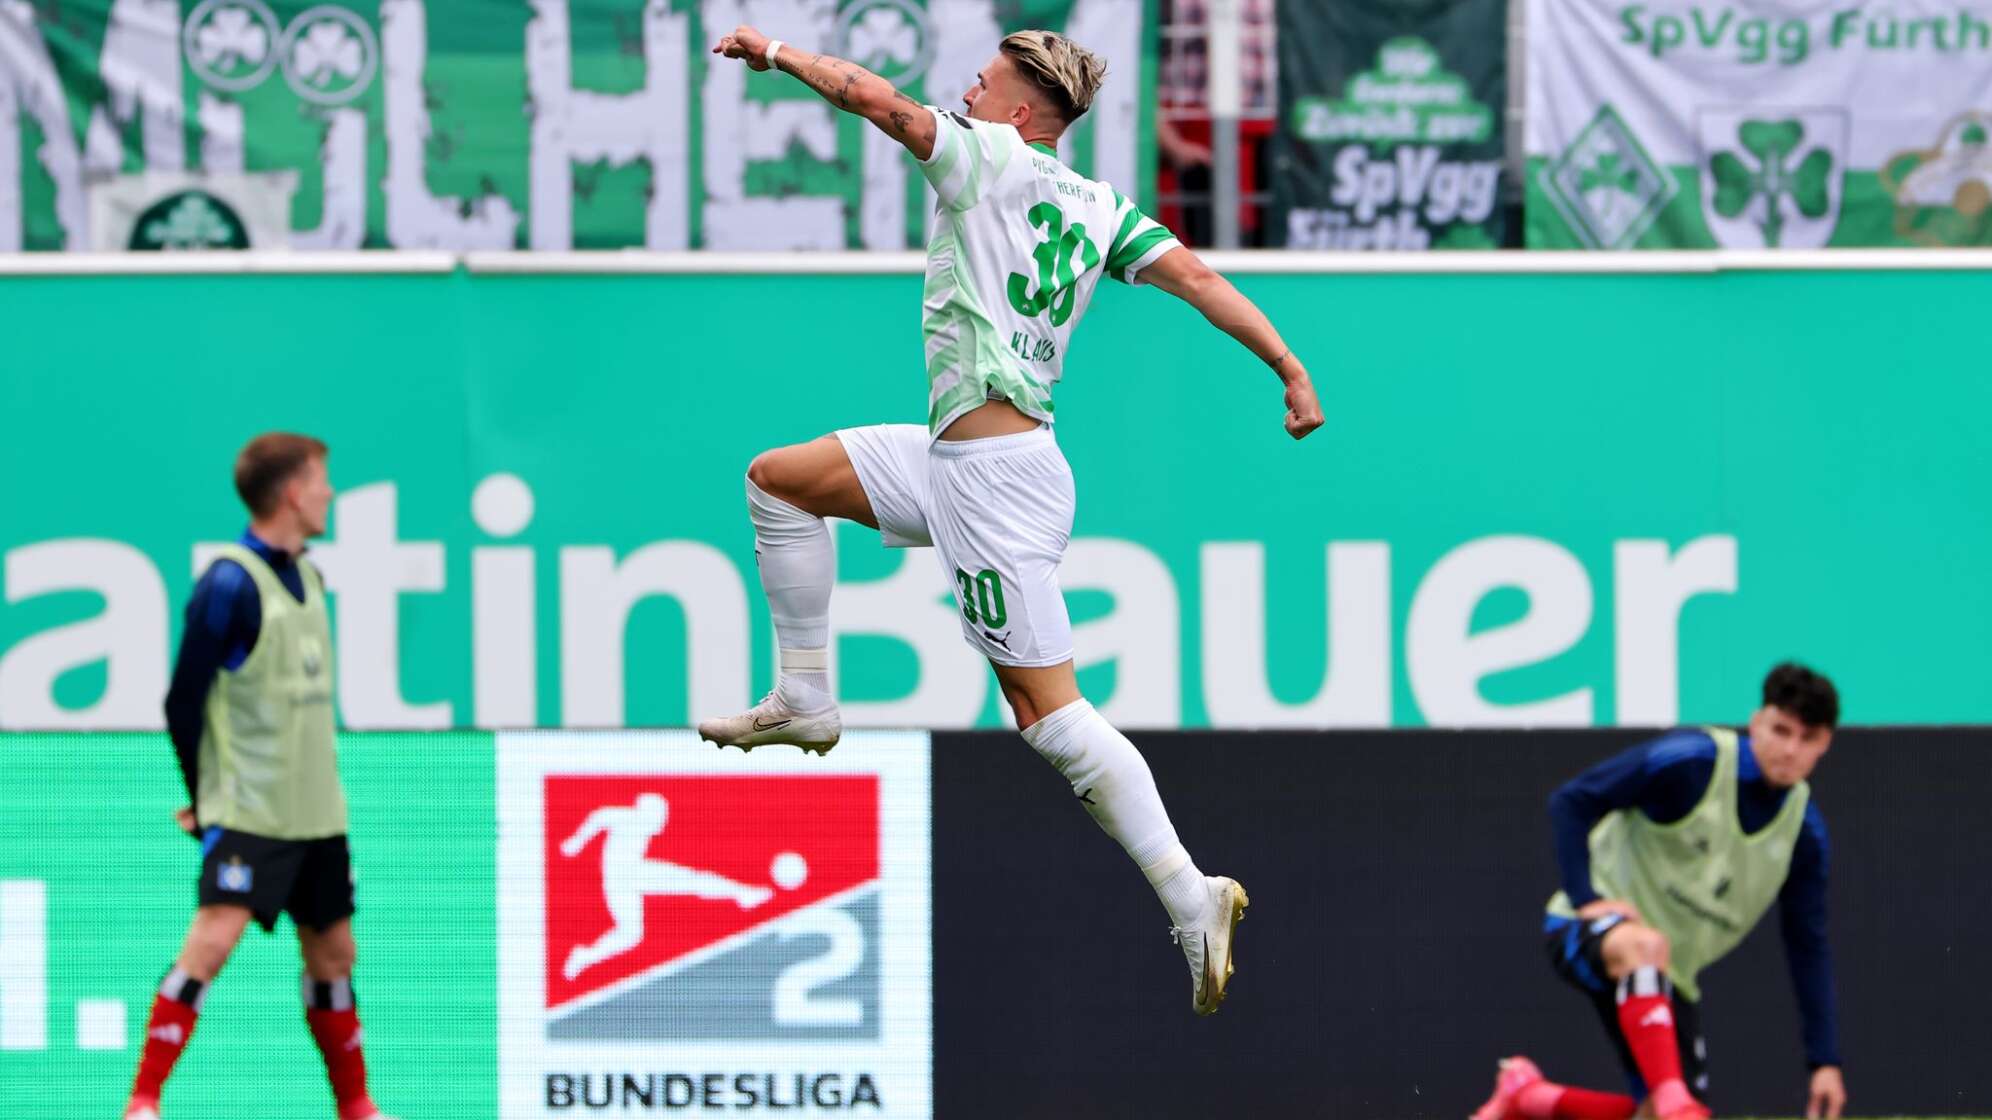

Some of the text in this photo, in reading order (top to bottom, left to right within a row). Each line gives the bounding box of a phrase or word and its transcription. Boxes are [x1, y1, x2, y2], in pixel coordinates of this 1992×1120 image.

[1618, 5, 1992, 66] SpVgg Fürth
[1331, 144, 1499, 223] SpVgg
[1007, 202, 1101, 327] 30
[956, 566, 1008, 629] 30
[772, 905, 866, 1029] 2
[545, 1073, 882, 1110] BUNDESLIGA
